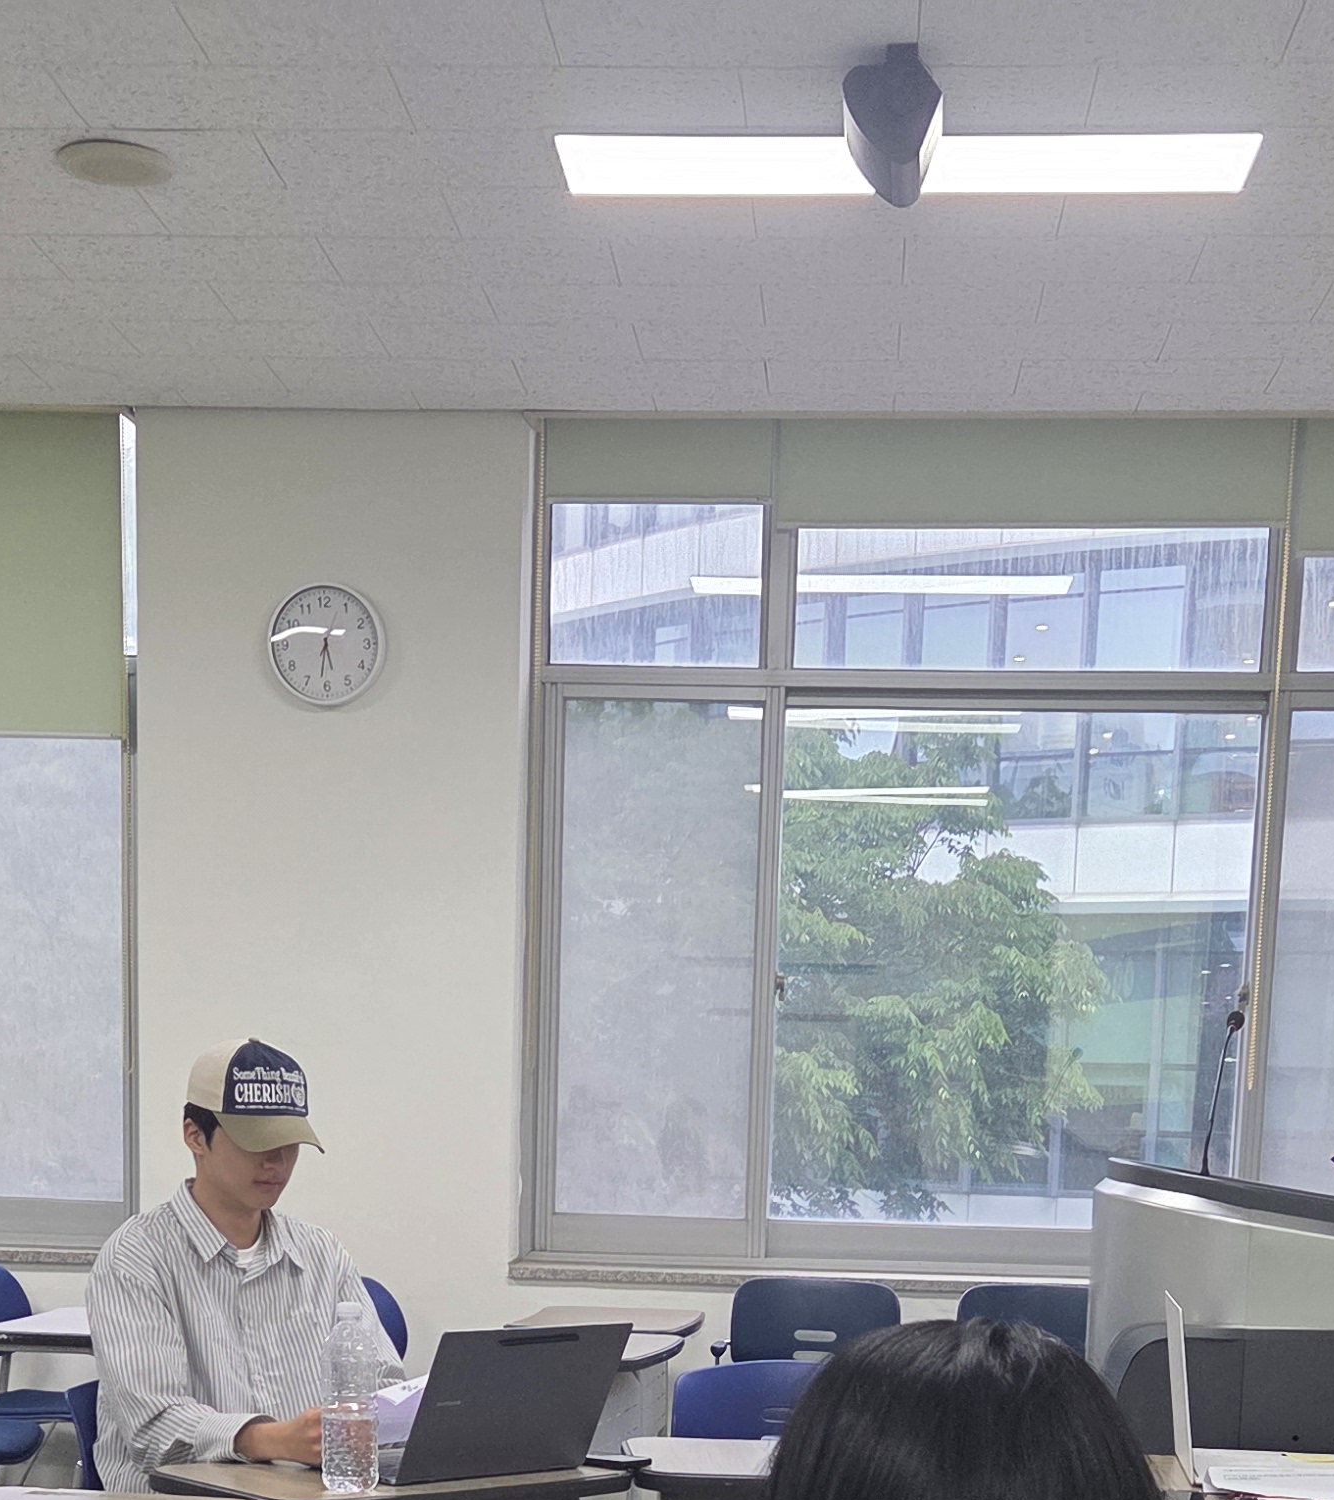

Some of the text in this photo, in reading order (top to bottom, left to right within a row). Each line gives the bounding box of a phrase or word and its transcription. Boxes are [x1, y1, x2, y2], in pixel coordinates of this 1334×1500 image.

[317, 596, 332, 608] 12
[343, 602, 348, 614] 1
[299, 603, 312, 615] 11
[357, 618, 365, 630] 2
[281, 639, 289, 651] 9
[362, 638, 371, 650] 3
[288, 660, 297, 672] 8
[357, 659, 365, 670] 4
[303, 675, 311, 687] 7
[323, 680, 332, 692] 6
[344, 675, 352, 687] 5
[234, 1082, 292, 1104] CHERISH
